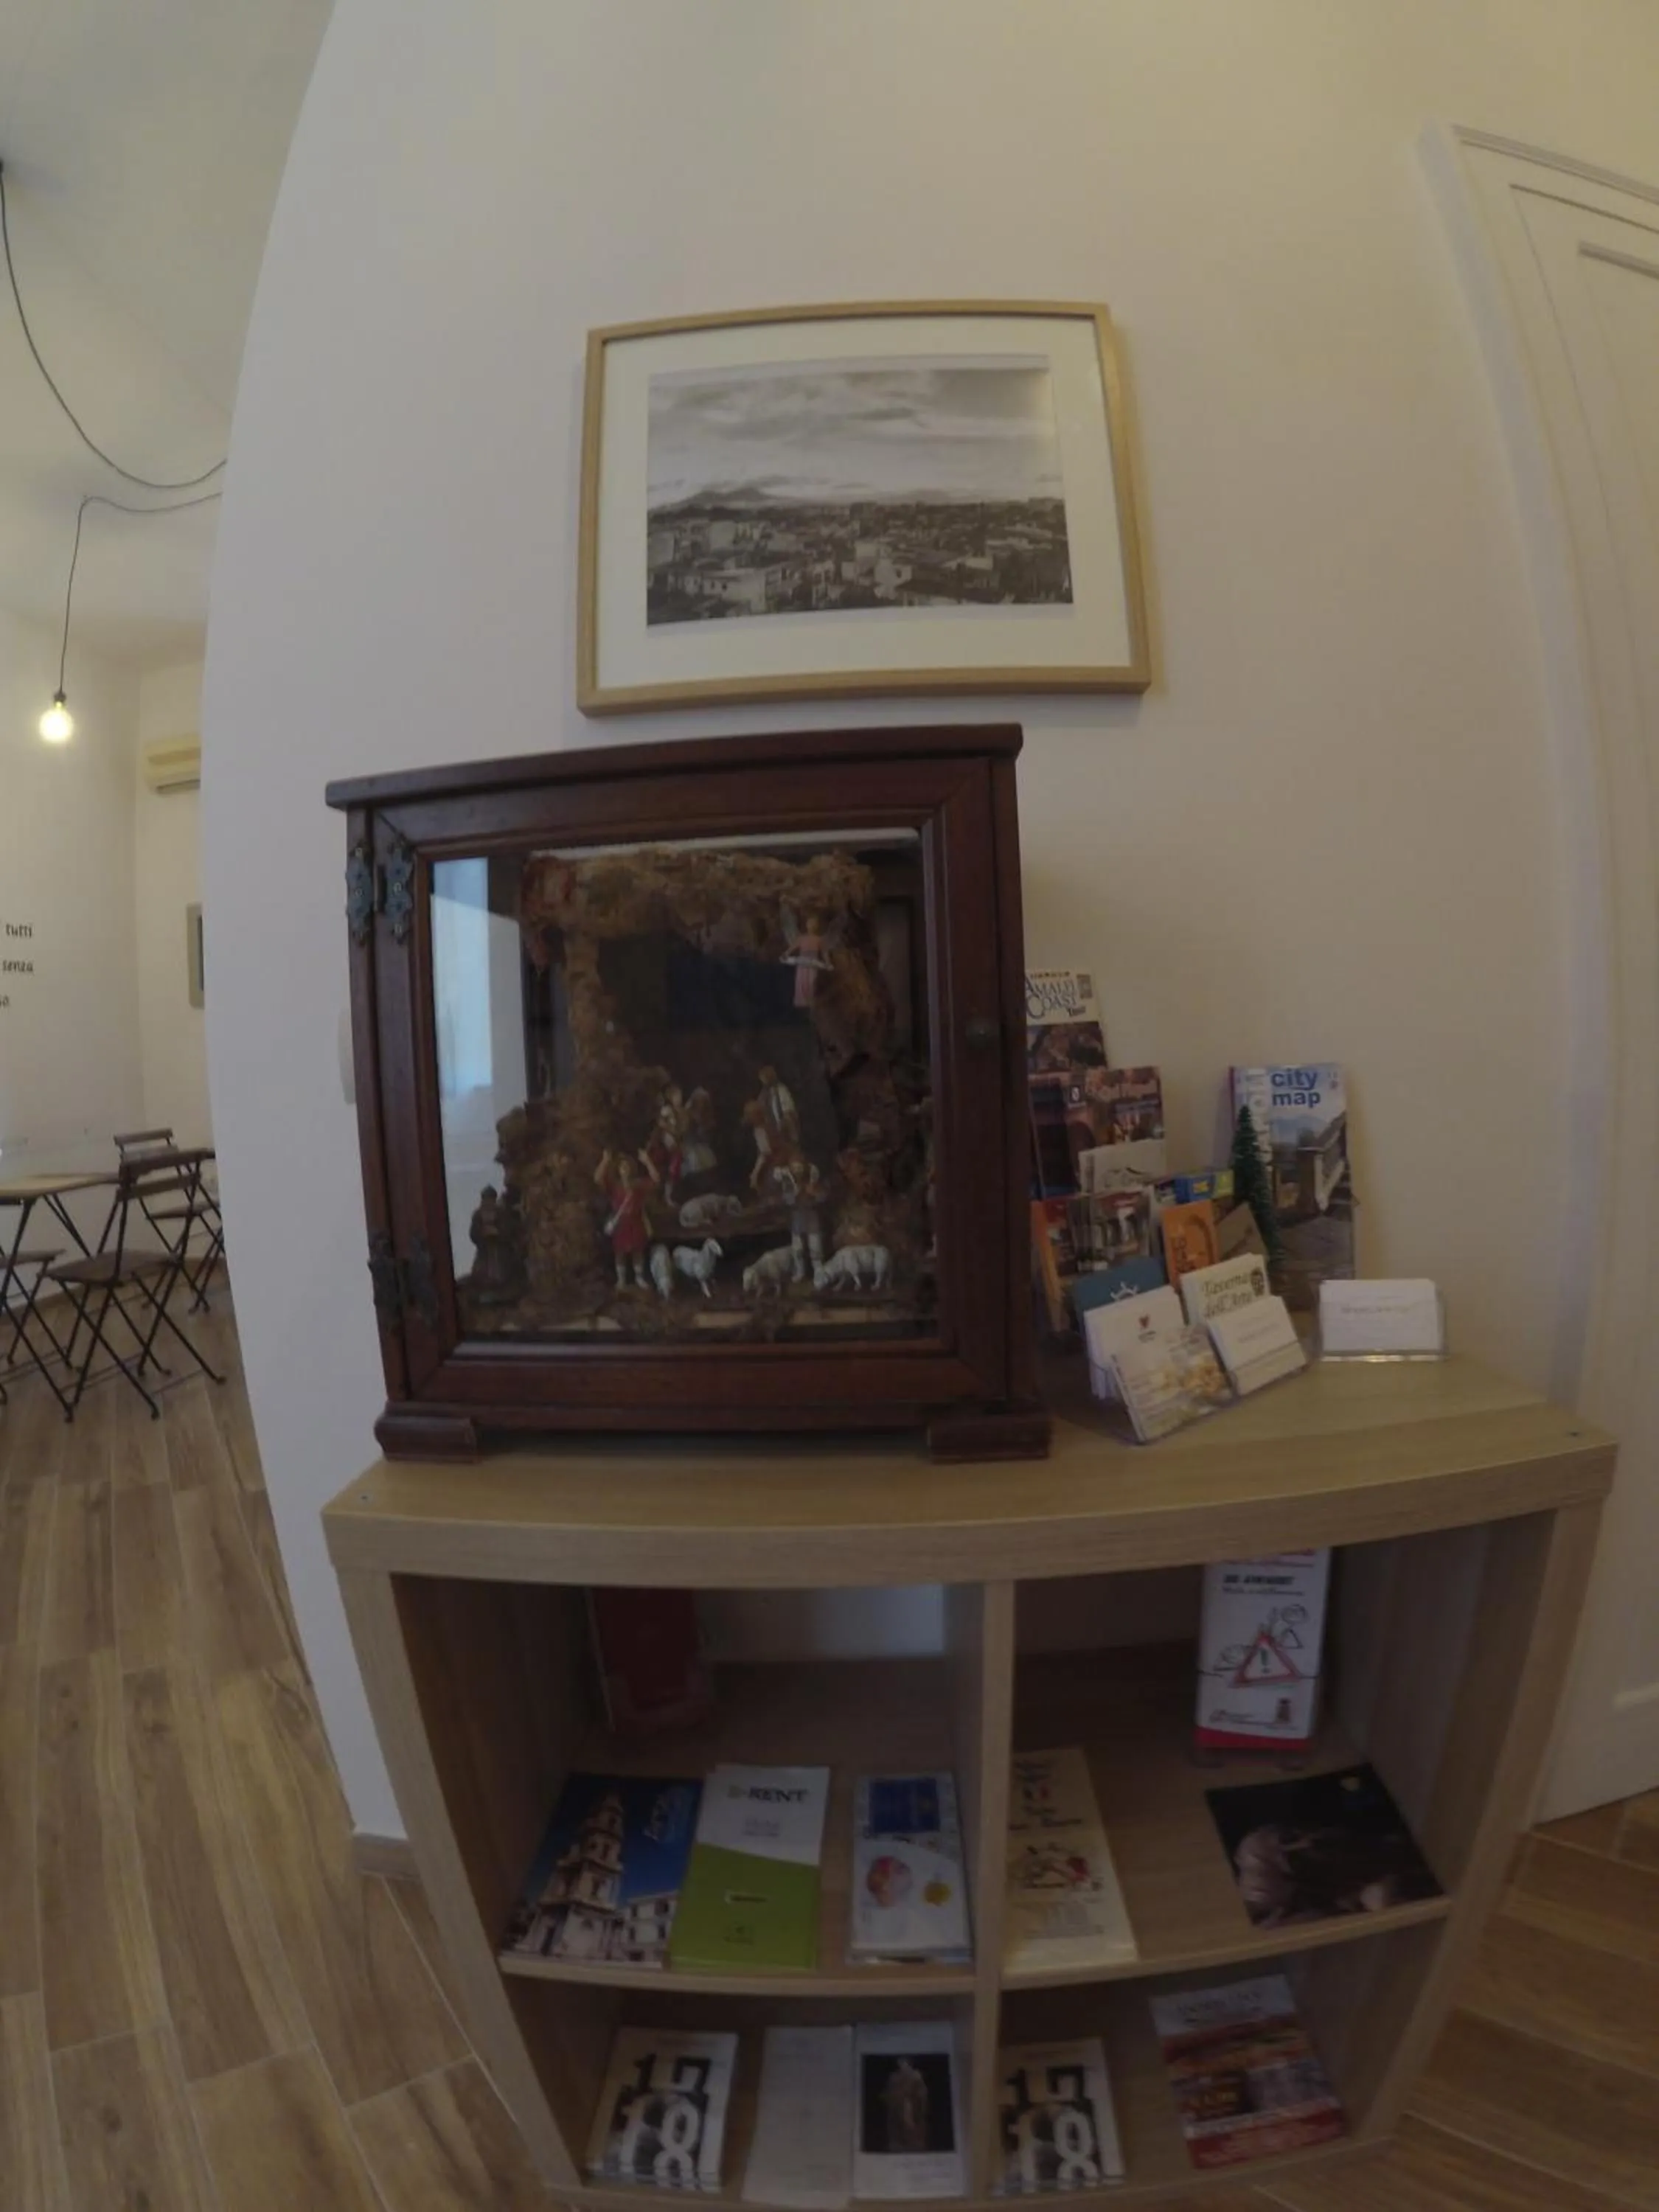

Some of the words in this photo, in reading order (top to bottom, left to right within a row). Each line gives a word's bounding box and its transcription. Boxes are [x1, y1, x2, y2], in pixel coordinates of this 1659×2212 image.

[6, 924, 32, 938] tutti
[2, 961, 34, 973] senza
[1271, 1068, 1318, 1091] city
[1272, 1092, 1321, 1107] map
